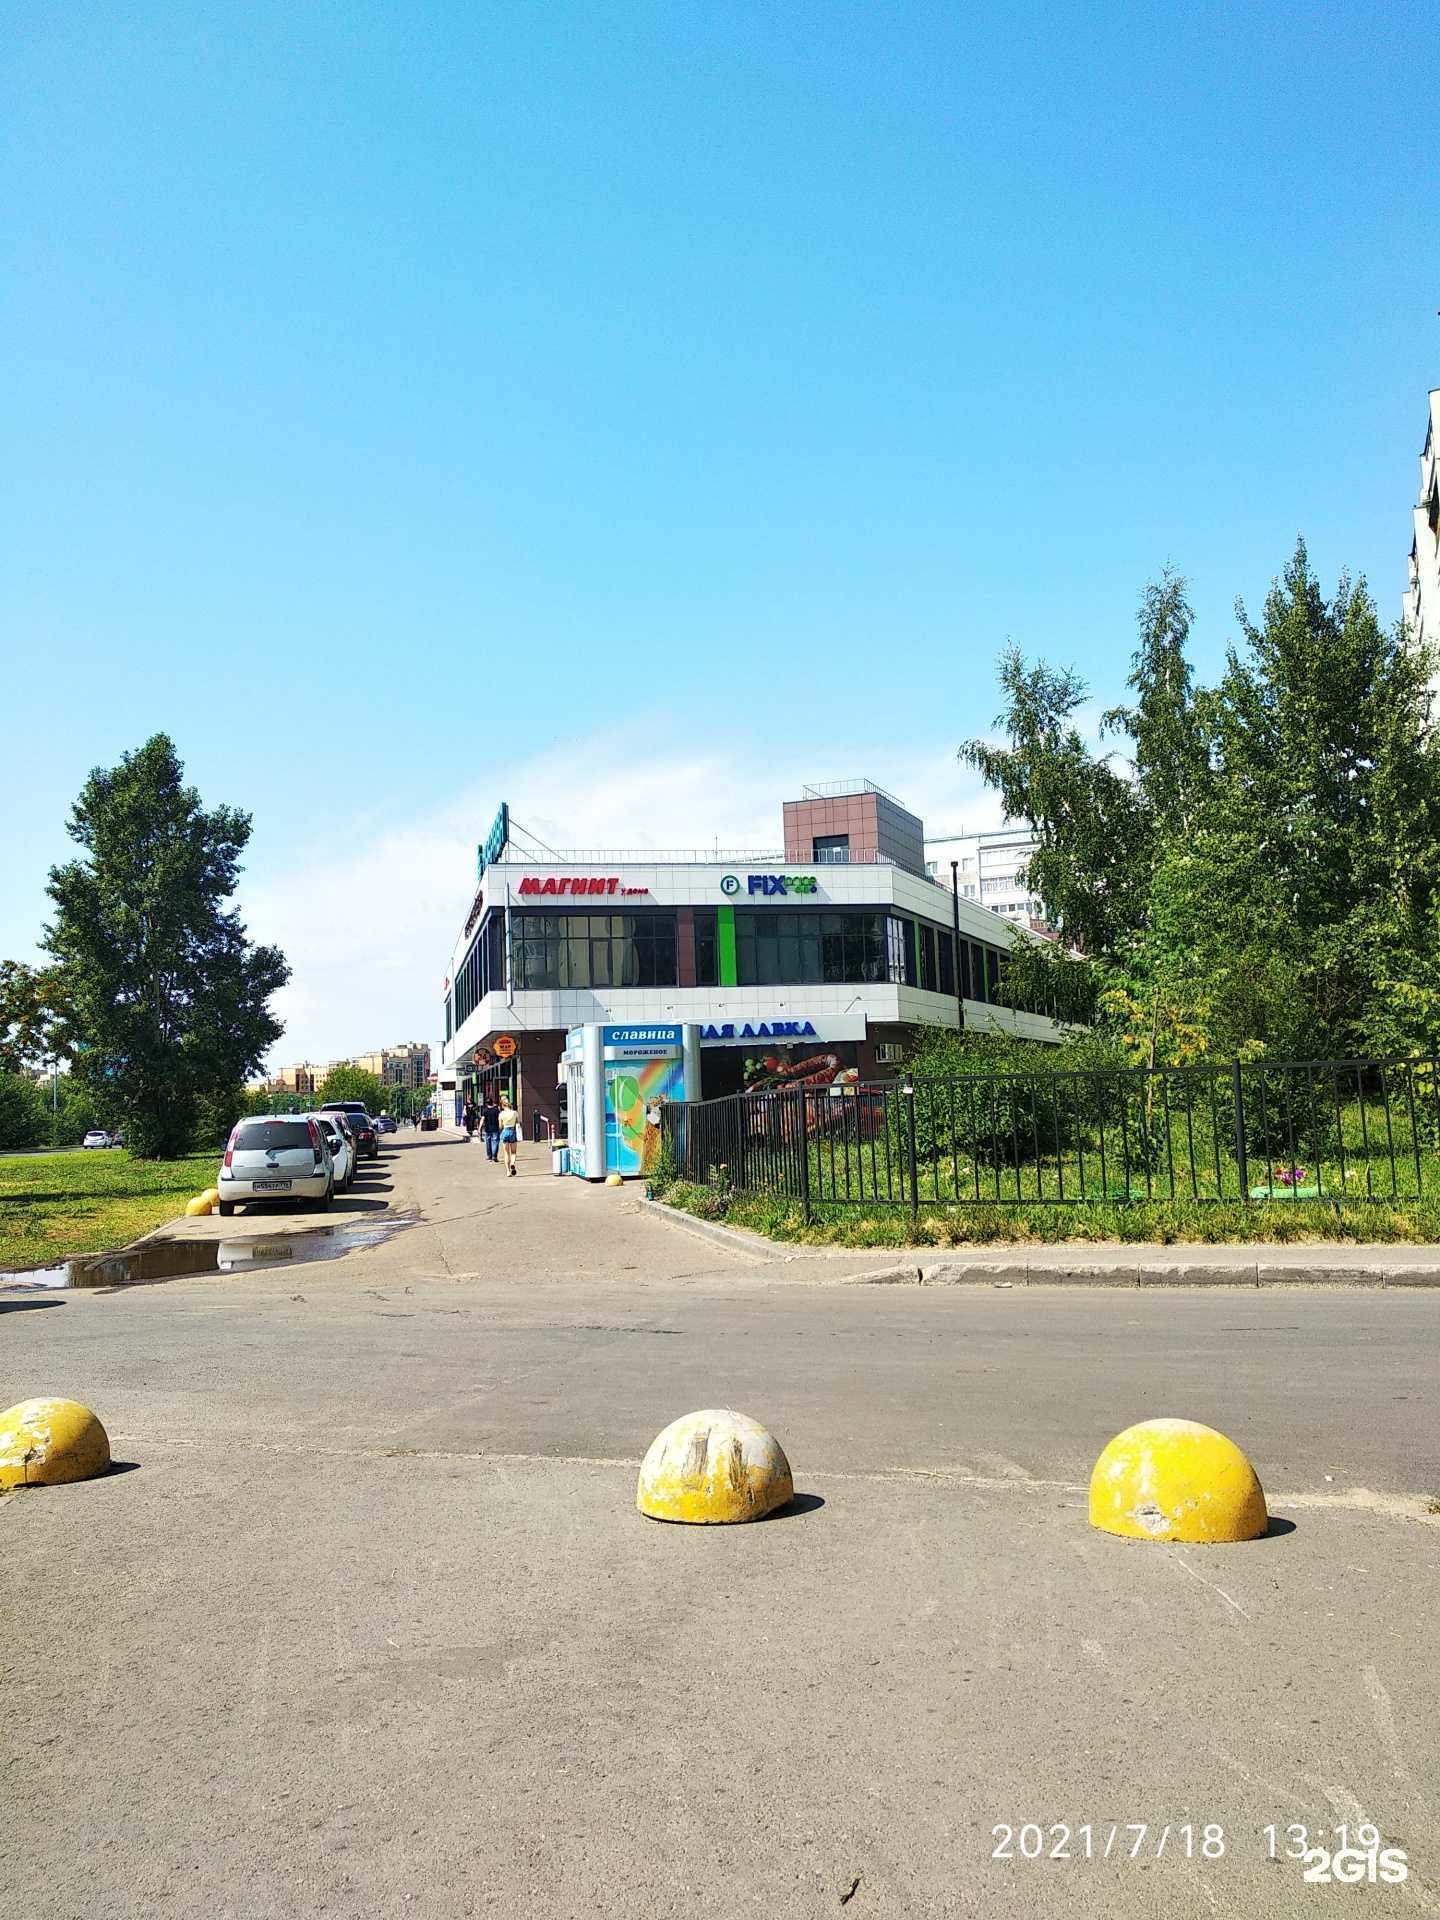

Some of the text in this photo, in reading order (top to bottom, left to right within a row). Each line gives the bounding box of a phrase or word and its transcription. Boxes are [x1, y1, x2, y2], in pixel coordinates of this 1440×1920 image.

[518, 877, 619, 895] МАГНИТ
[612, 1030, 675, 1041] славица
[740, 1021, 817, 1038] ЛАВКА
